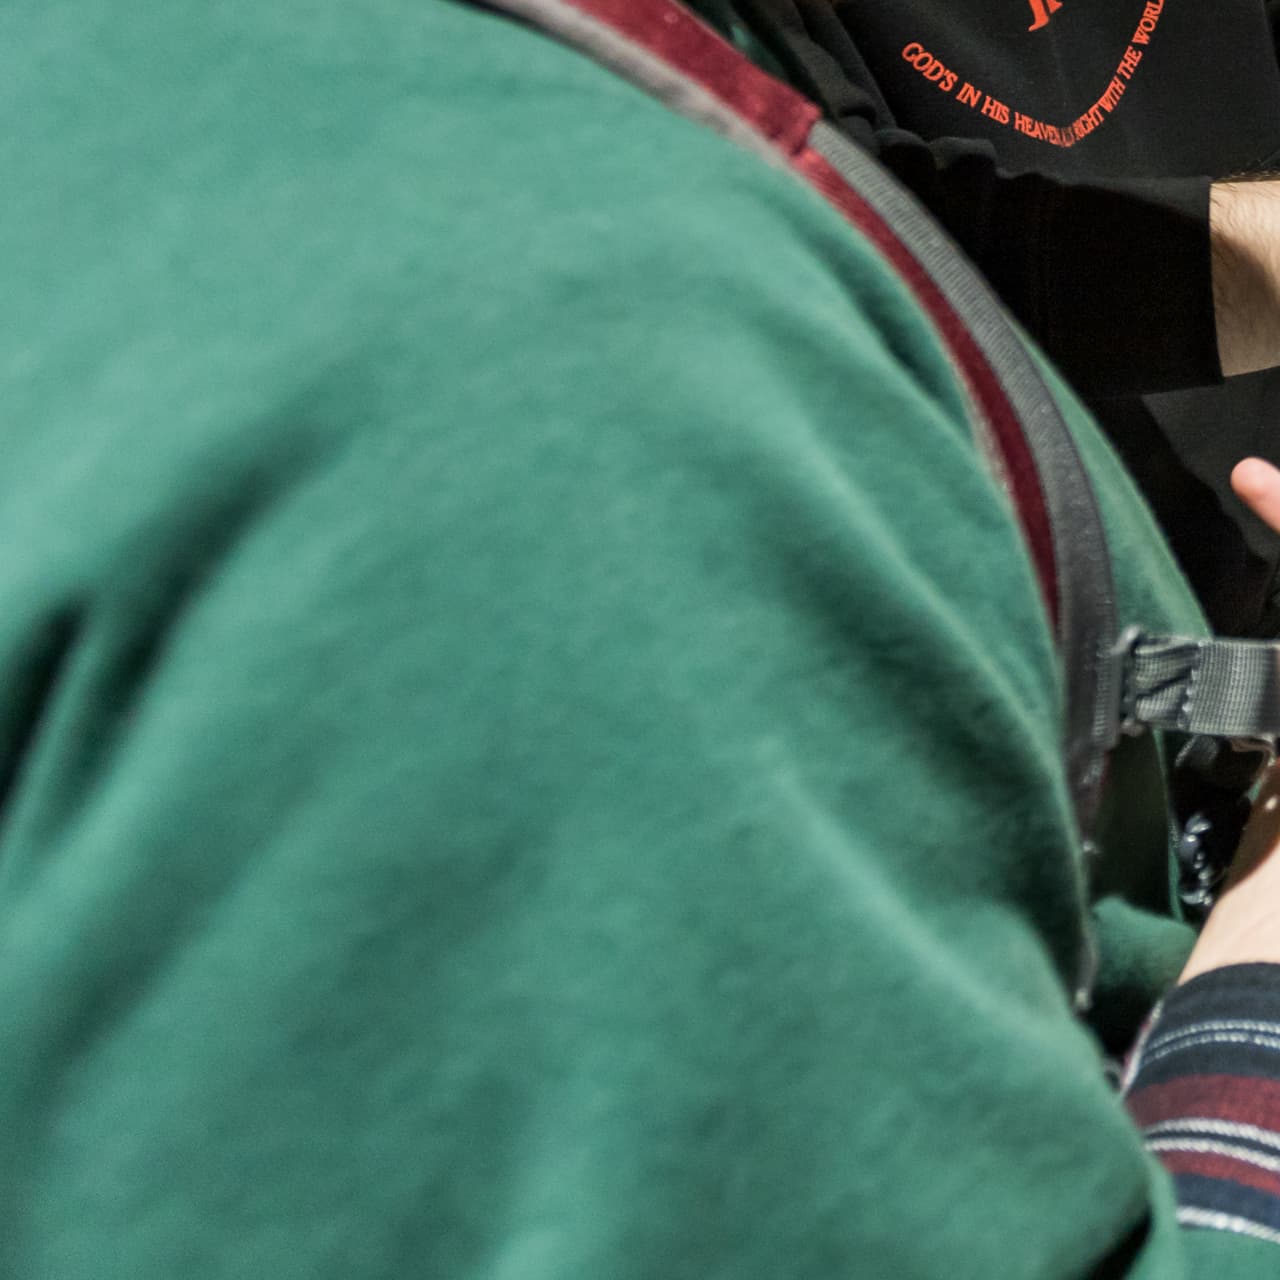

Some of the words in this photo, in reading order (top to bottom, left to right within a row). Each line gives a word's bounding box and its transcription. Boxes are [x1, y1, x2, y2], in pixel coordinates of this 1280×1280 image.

[902, 42, 958, 92] GOD'S
[956, 82, 982, 108] IN
[981, 95, 1010, 125] HIS
[1098, 76, 1126, 113] WITH
[1117, 45, 1143, 80] THE
